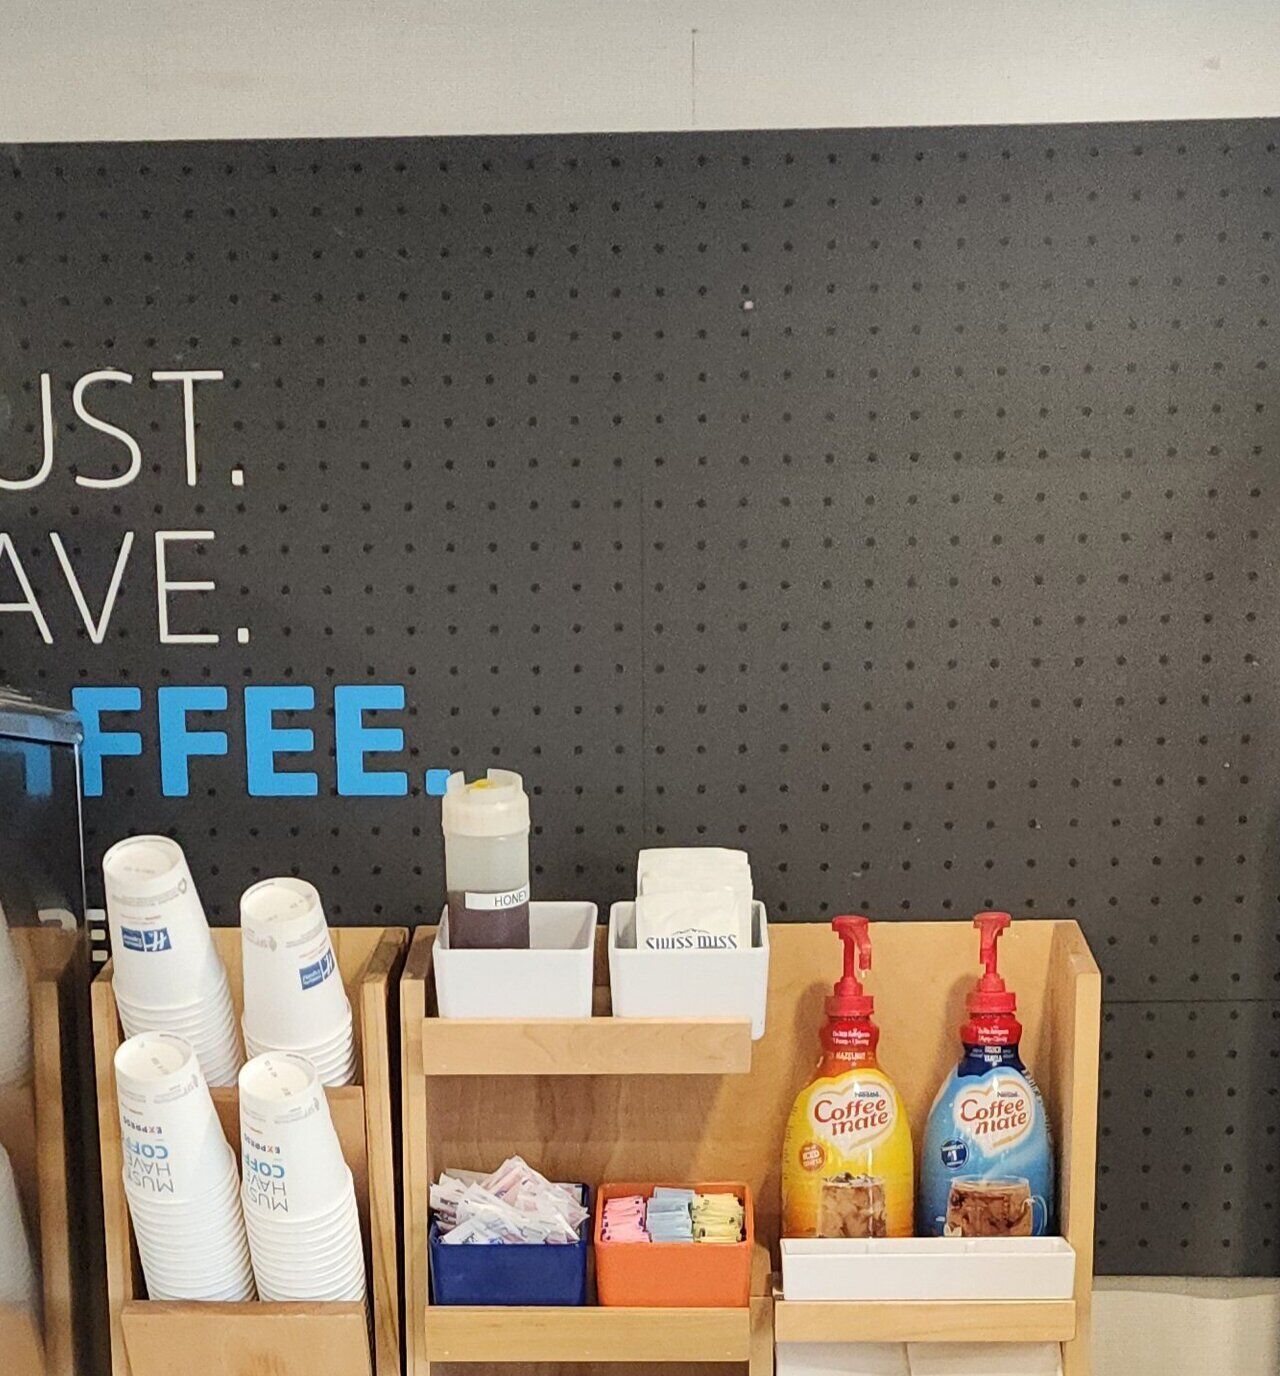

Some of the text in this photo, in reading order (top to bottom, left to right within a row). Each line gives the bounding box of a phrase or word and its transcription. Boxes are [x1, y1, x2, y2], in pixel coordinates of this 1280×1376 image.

[494, 888, 528, 908] HONEY
[814, 1099, 887, 1123] Coffee
[960, 1098, 1025, 1122] Coffee
[831, 1111, 889, 1136] mate
[975, 1110, 1028, 1135] mate
